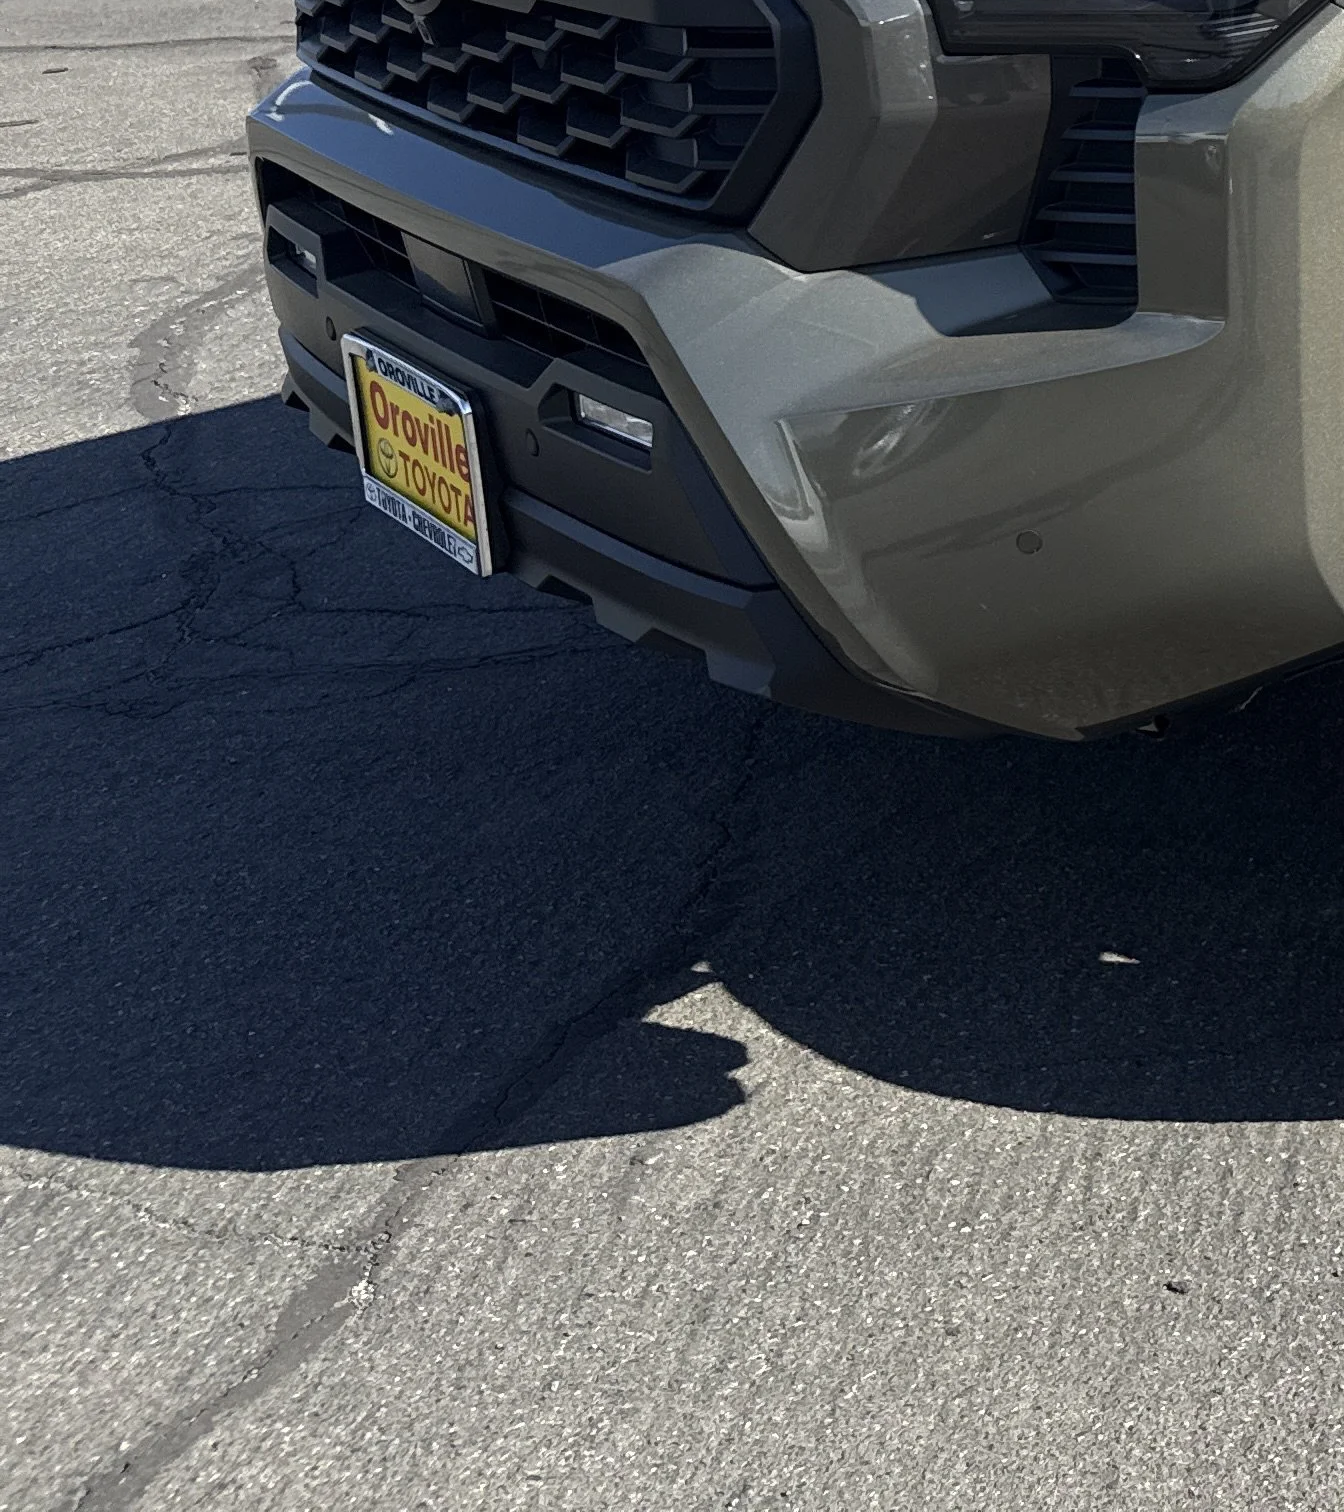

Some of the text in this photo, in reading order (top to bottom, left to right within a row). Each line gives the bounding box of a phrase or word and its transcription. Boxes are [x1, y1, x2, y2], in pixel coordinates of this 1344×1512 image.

[377, 356, 437, 405] OROVILLE
[369, 380, 470, 483] Oroville
[376, 487, 457, 557] TOYOTA CHEVROLET
[398, 449, 476, 527] TOYOTA
